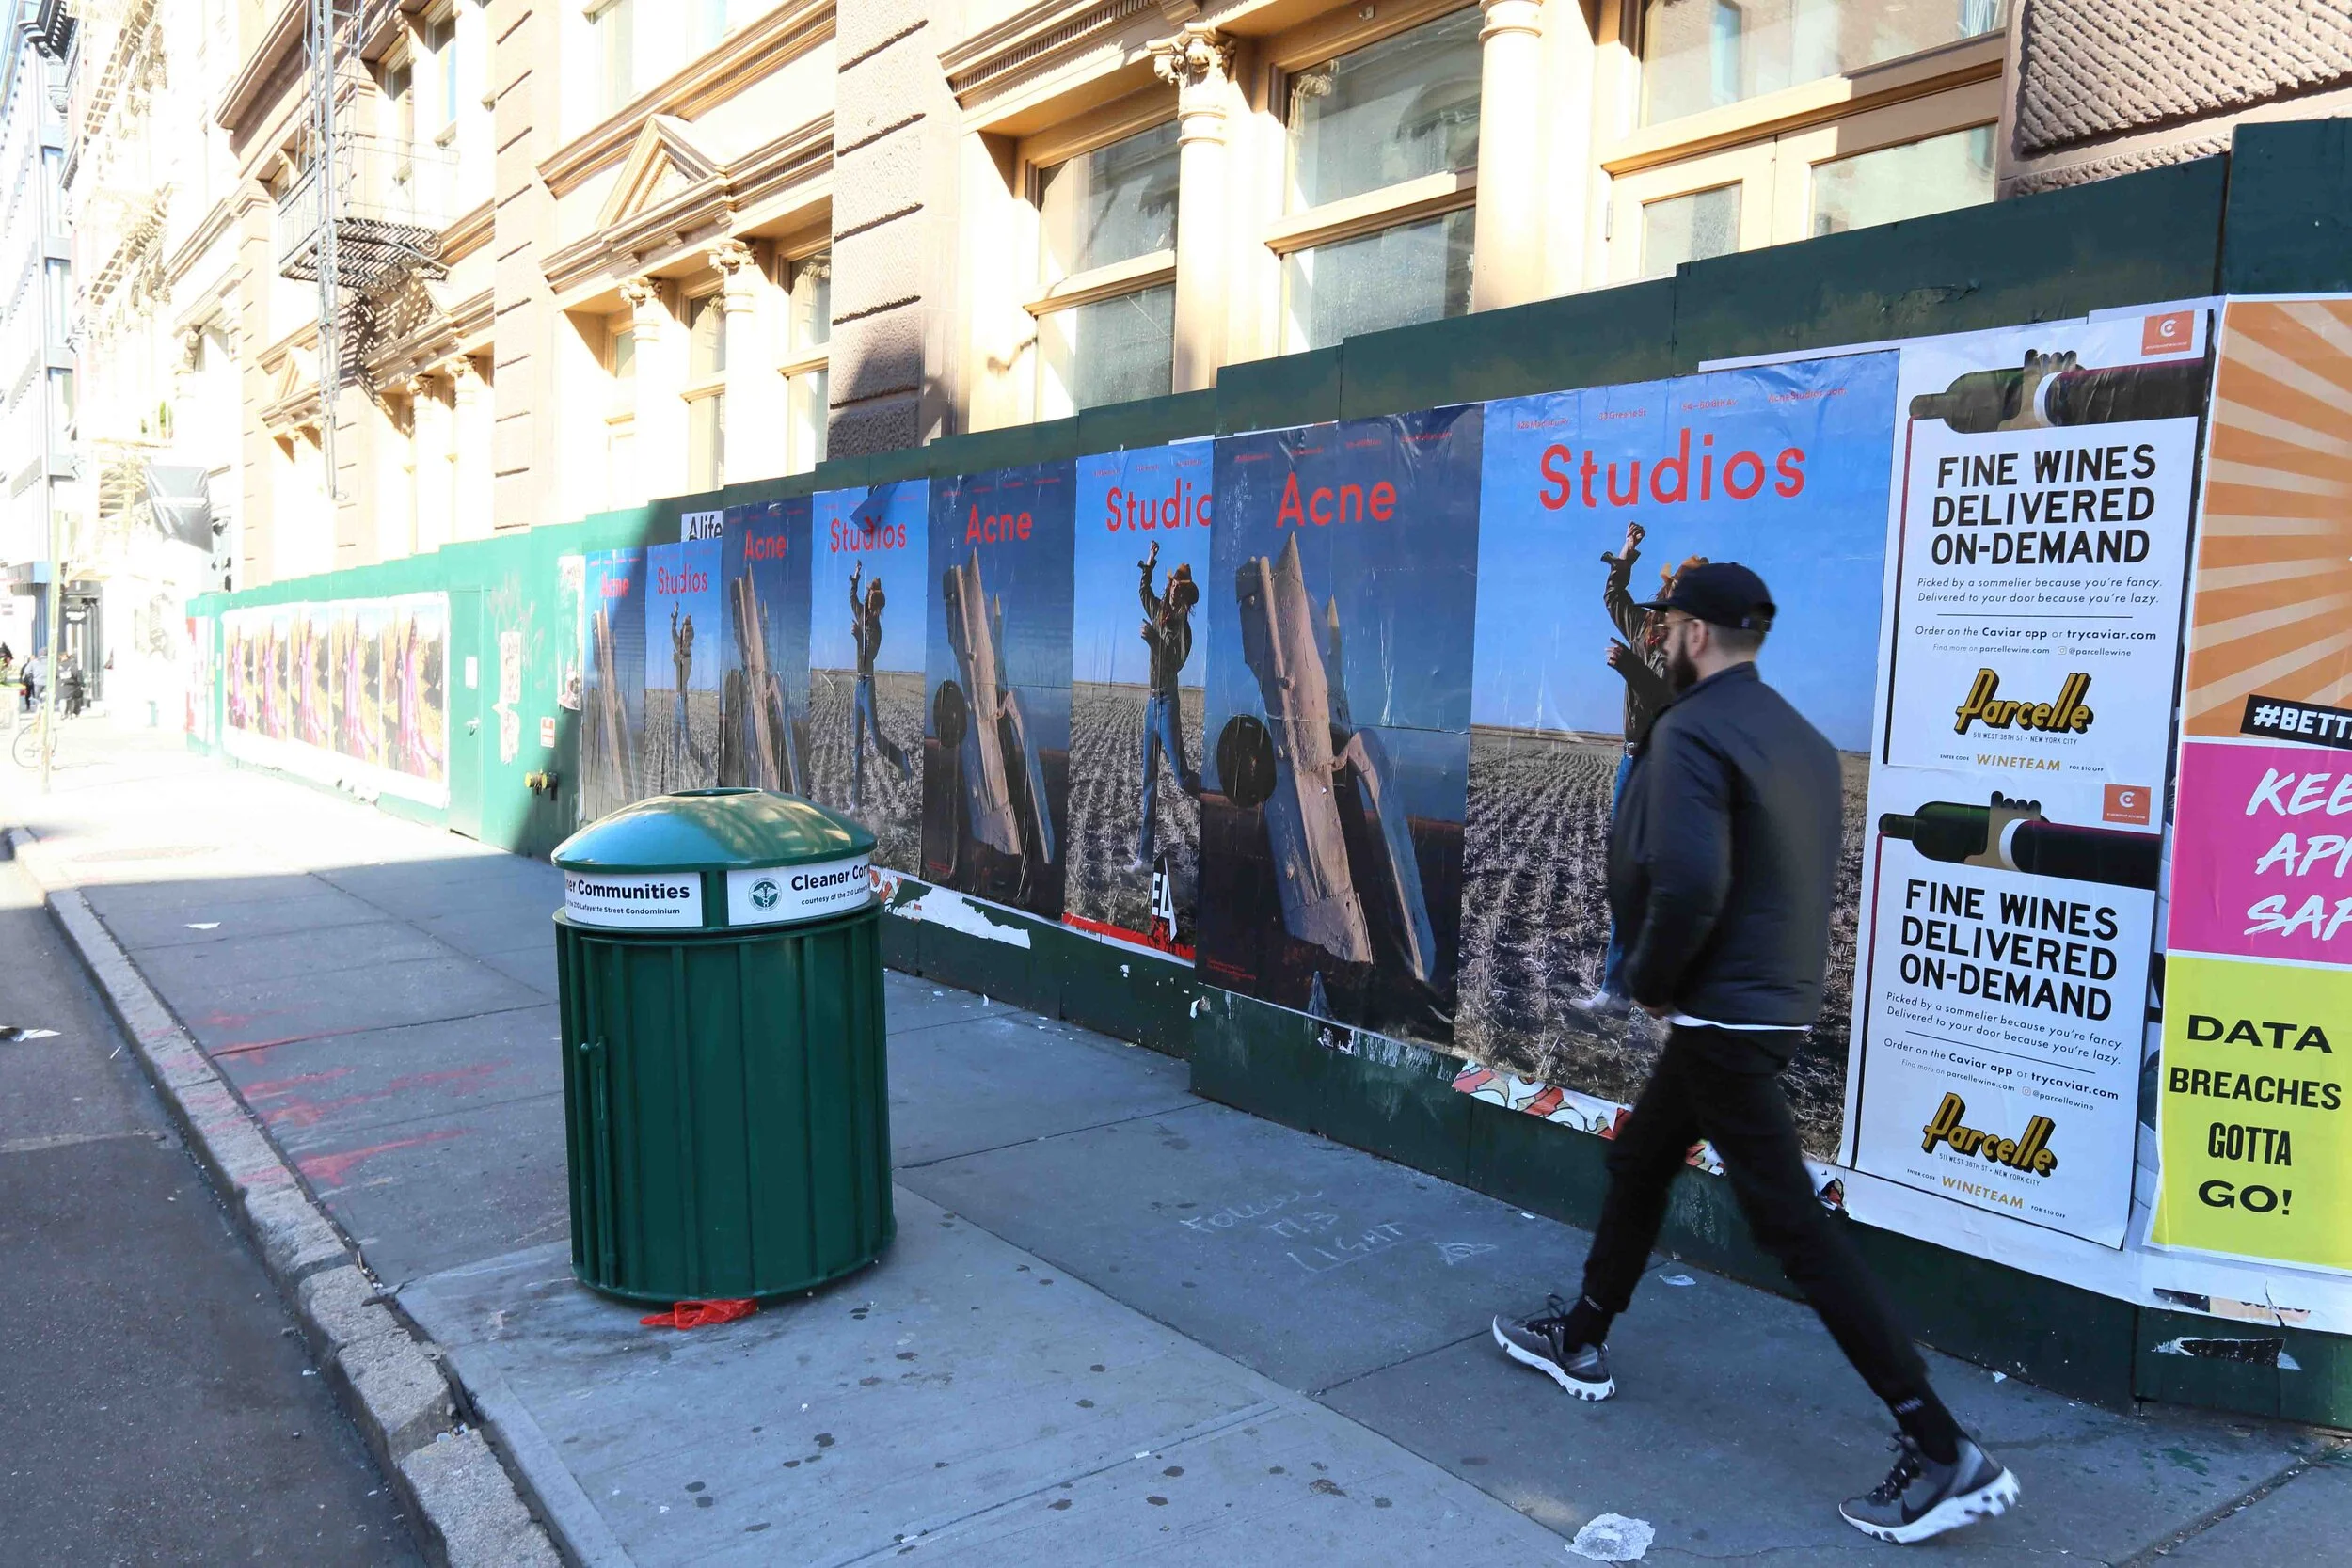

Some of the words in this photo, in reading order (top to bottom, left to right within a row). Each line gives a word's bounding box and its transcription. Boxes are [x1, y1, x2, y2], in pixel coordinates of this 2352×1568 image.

[1539, 428, 1805, 510] Studios
[1937, 453, 2018, 489] FINE
[2034, 444, 2156, 483] WINES
[1276, 471, 1397, 528] Acne
[1932, 487, 2155, 527] DELIVERED
[689, 515, 723, 542] Alife
[830, 515, 907, 554] Studios
[965, 503, 1033, 546] Acne
[744, 530, 787, 562] Acne
[1931, 529, 2151, 566] ON-DEMAND
[600, 572, 629, 597] Acne
[658, 564, 707, 595] Studios
[1917, 578, 1949, 587] Picked
[1952, 578, 1964, 589] by
[1978, 578, 2032, 587] sommelier
[2035, 578, 2081, 587] because
[2085, 578, 2122, 589] you're
[2126, 576, 2162, 589] fancy.
[1917, 593, 1966, 602] Delivered
[1969, 593, 1979, 602] to
[1981, 595, 2007, 605] your
[2010, 593, 2035, 603] door
[2038, 593, 2085, 603] because
[2088, 593, 2126, 606] you're
[2130, 593, 2159, 606] lazy.
[1915, 626, 1946, 636] Order
[1963, 626, 1979, 636] the
[1982, 627, 2021, 638] Caviar
[2025, 630, 2047, 640] app
[2067, 629, 2156, 641] trycaviar.com
[1979, 644, 2050, 655] parcellewine.com
[2068, 647, 2132, 657] @parcellewine
[1954, 668, 2094, 735] Parcelle
[2254, 705, 2352, 739] #BETT
[1976, 753, 2061, 771] WINETEAM
[578, 879, 691, 899] Communities
[791, 870, 850, 892] Cleaner
[802, 895, 830, 905] courtesy
[604, 906, 624, 914] Street
[1906, 879, 1985, 920] FINE
[2000, 892, 2119, 941] WINES
[1900, 914, 2117, 981] DELIVERED
[1900, 953, 2111, 1022] ON-DEMAND
[1886, 991, 1917, 1006] Picked
[1920, 998, 1932, 1010] by
[1946, 1006, 1998, 1022] sommelier
[2000, 1015, 2045, 1033] because
[2049, 1027, 2085, 1040] you're
[2089, 1033, 2124, 1051] fancy.
[1887, 1006, 1933, 1023] Delivered
[1936, 1018, 1946, 1026] to
[1948, 1022, 1973, 1032] your
[1976, 1025, 2000, 1038] door
[2004, 1031, 2049, 1048] because
[2052, 1042, 2089, 1057] you're
[2092, 1050, 2121, 1065] lazy.
[2187, 1014, 2333, 1053] DATA
[1883, 1038, 1914, 1053] Order
[1931, 1049, 1946, 1059] the
[1949, 1053, 1987, 1069] Caviar
[1991, 1065, 2013, 1076] app
[2032, 1072, 2119, 1100] trycaviar.com
[1901, 1058, 1915, 1068] Find
[1917, 1064, 1934, 1072] more
[1947, 1070, 2015, 1091] parcellewine.com
[2032, 1090, 2094, 1110] @parcellewine
[2169, 1067, 2342, 1110] BREACHES
[1921, 1091, 2058, 1178] Parcelle
[2207, 1122, 2292, 1166] GOTTA
[1949, 1157, 1963, 1165] WEST
[1994, 1168, 2008, 1178] NEW
[2009, 1172, 2025, 1182] YORK
[2026, 1178, 2040, 1186] CITY
[1942, 1176, 2023, 1208] WINETEAM
[2198, 1180, 2292, 1215] GO!
